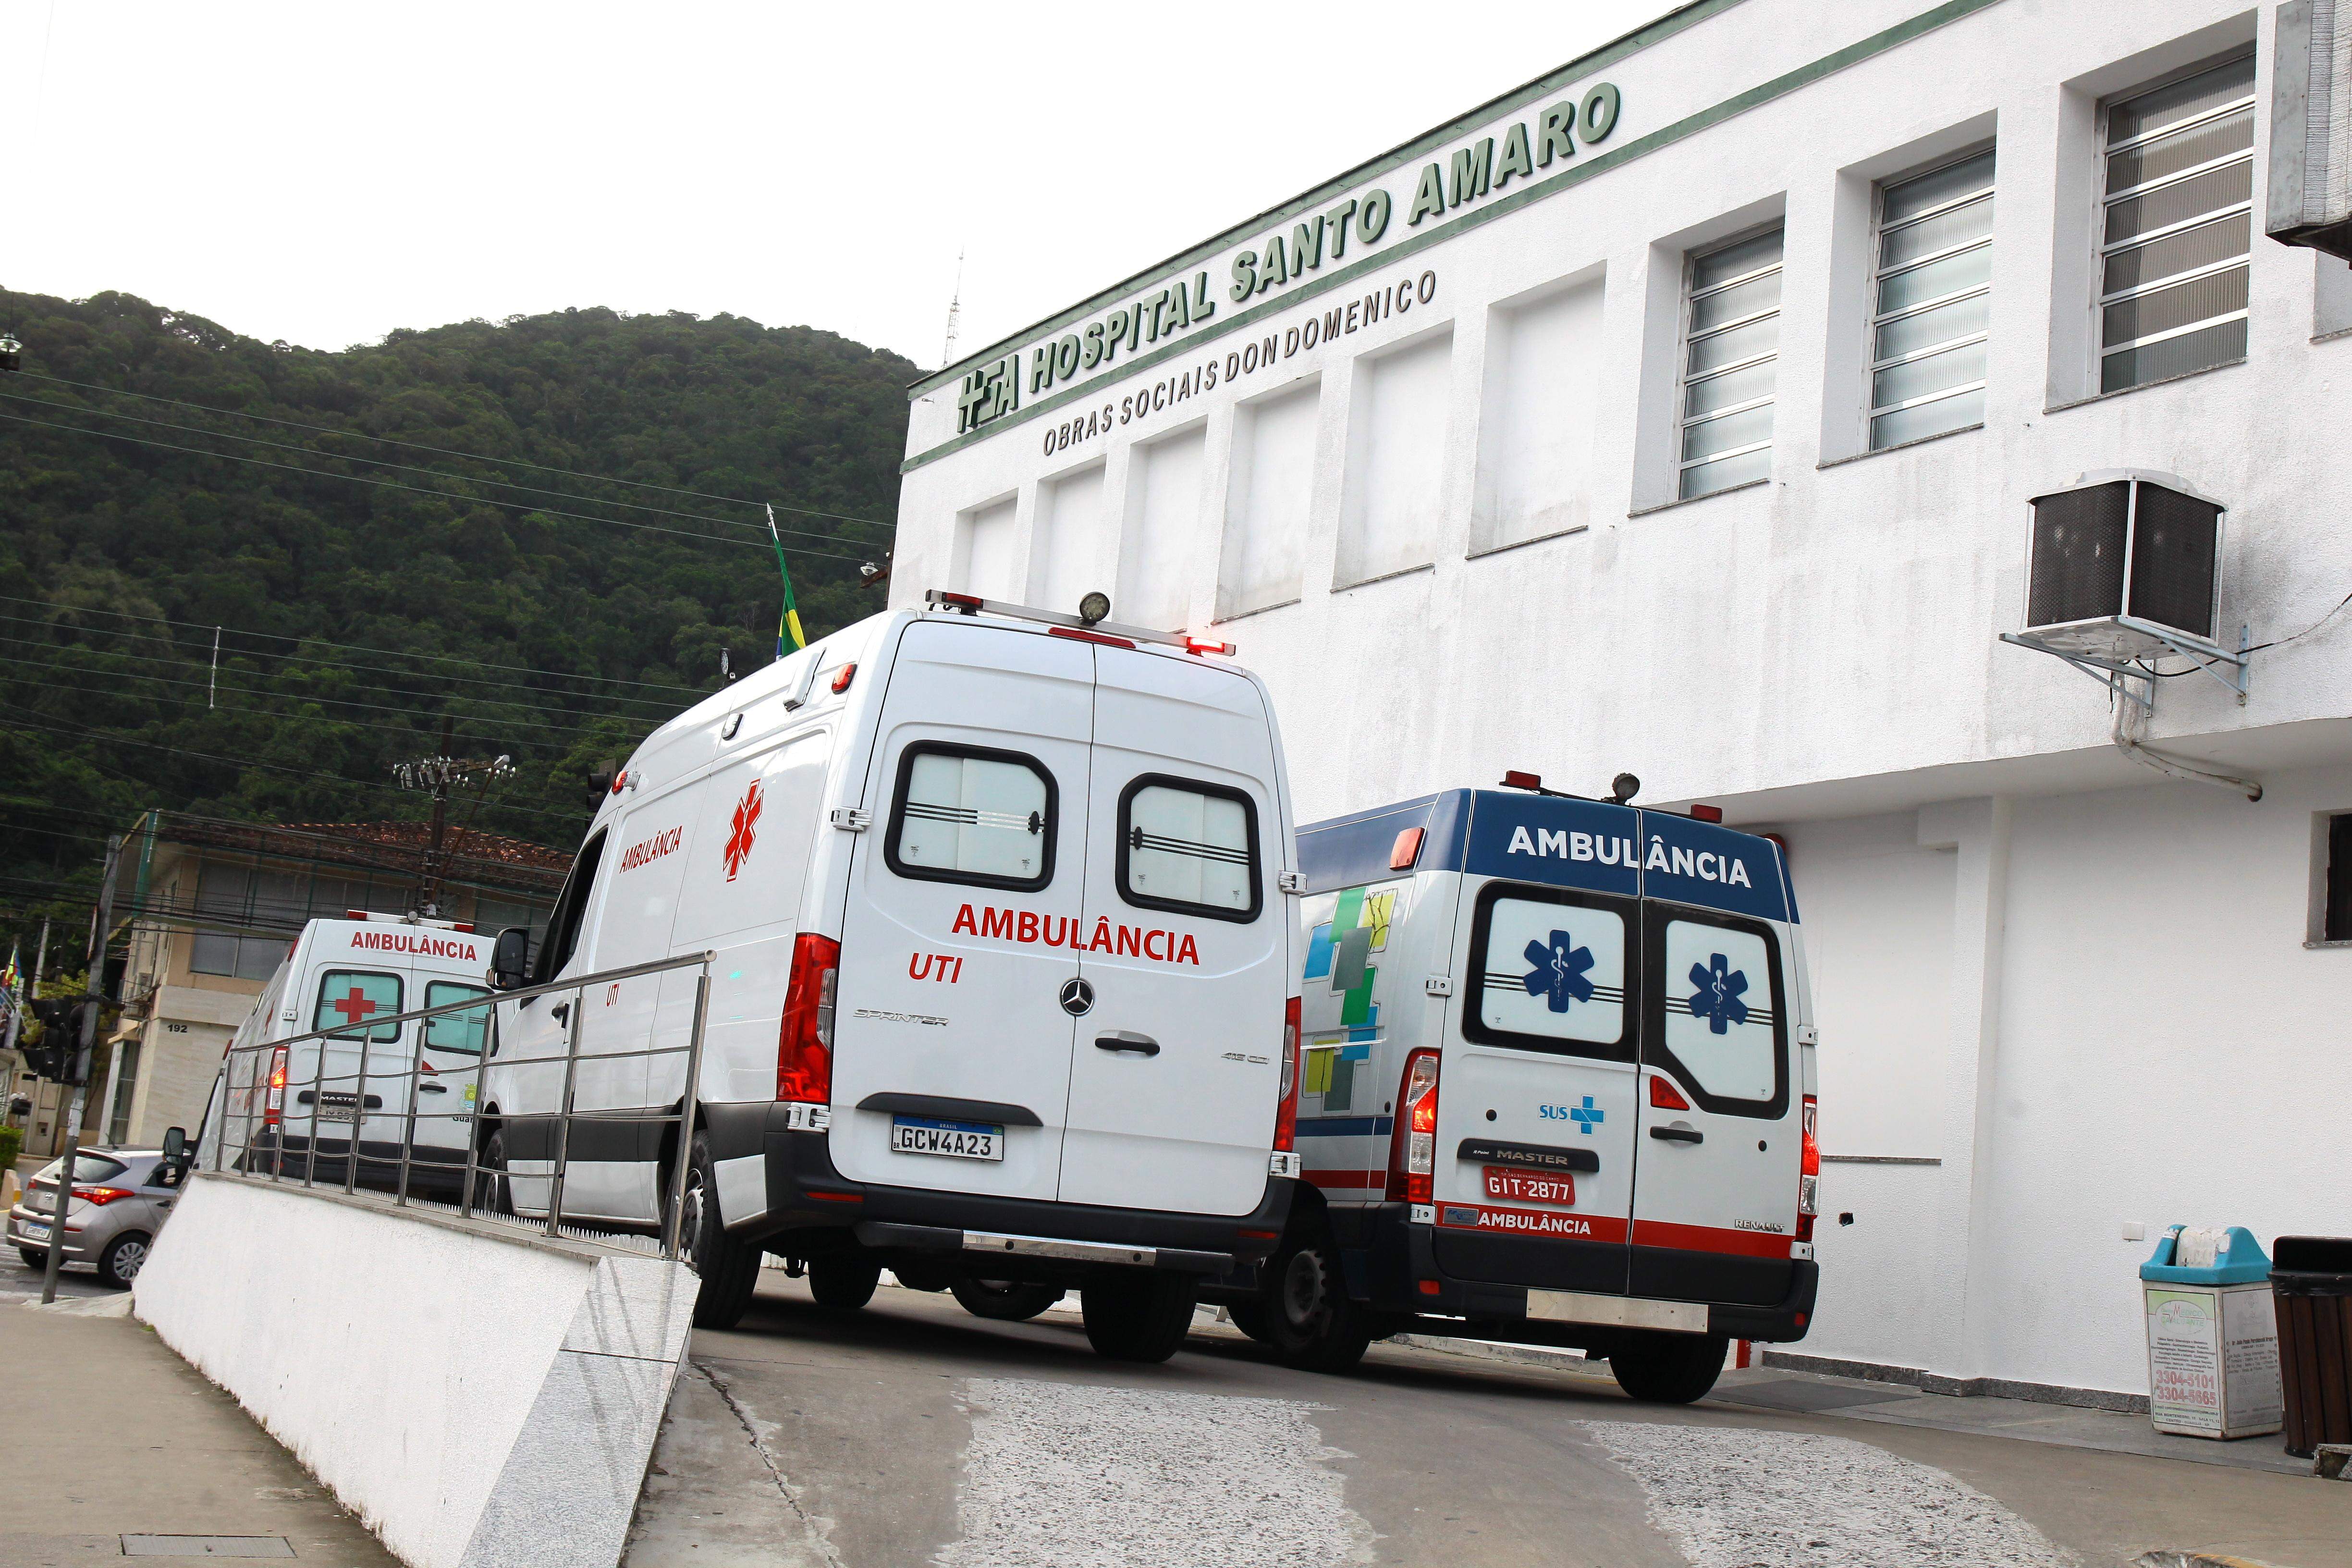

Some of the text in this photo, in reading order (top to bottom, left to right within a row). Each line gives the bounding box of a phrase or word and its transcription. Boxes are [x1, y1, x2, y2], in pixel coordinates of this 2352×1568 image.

[1029, 271, 1215, 393] HOSPITAL
[1229, 189, 1391, 302] SANTO
[1408, 82, 1620, 226] AMARO
[1044, 270, 1435, 455] OBRAS SOCIAIS DON DOMENICO
[619, 825, 683, 874] AMBULÂNCIA
[1507, 826, 1752, 889] AMBULÂNCIA
[350, 931, 477, 961] AMBULÂNCIA
[952, 903, 1200, 966] AMBULÂNCIA
[908, 953, 963, 983] UTI
[606, 983, 619, 1006] UTI
[168, 1024, 187, 1033] 192
[853, 1008, 949, 1026] SPRINTER
[1540, 1105, 1568, 1120] SUS
[902, 1128, 991, 1155] GCW4A23
[1497, 1150, 1568, 1165] MASTER
[1478, 1213, 1591, 1235] AMBULÂNCIA
[1735, 1219, 1784, 1232] RENAULT
[2156, 1370, 2214, 1389] 3304-5101
[2157, 1385, 2217, 1406] 3304-5665
